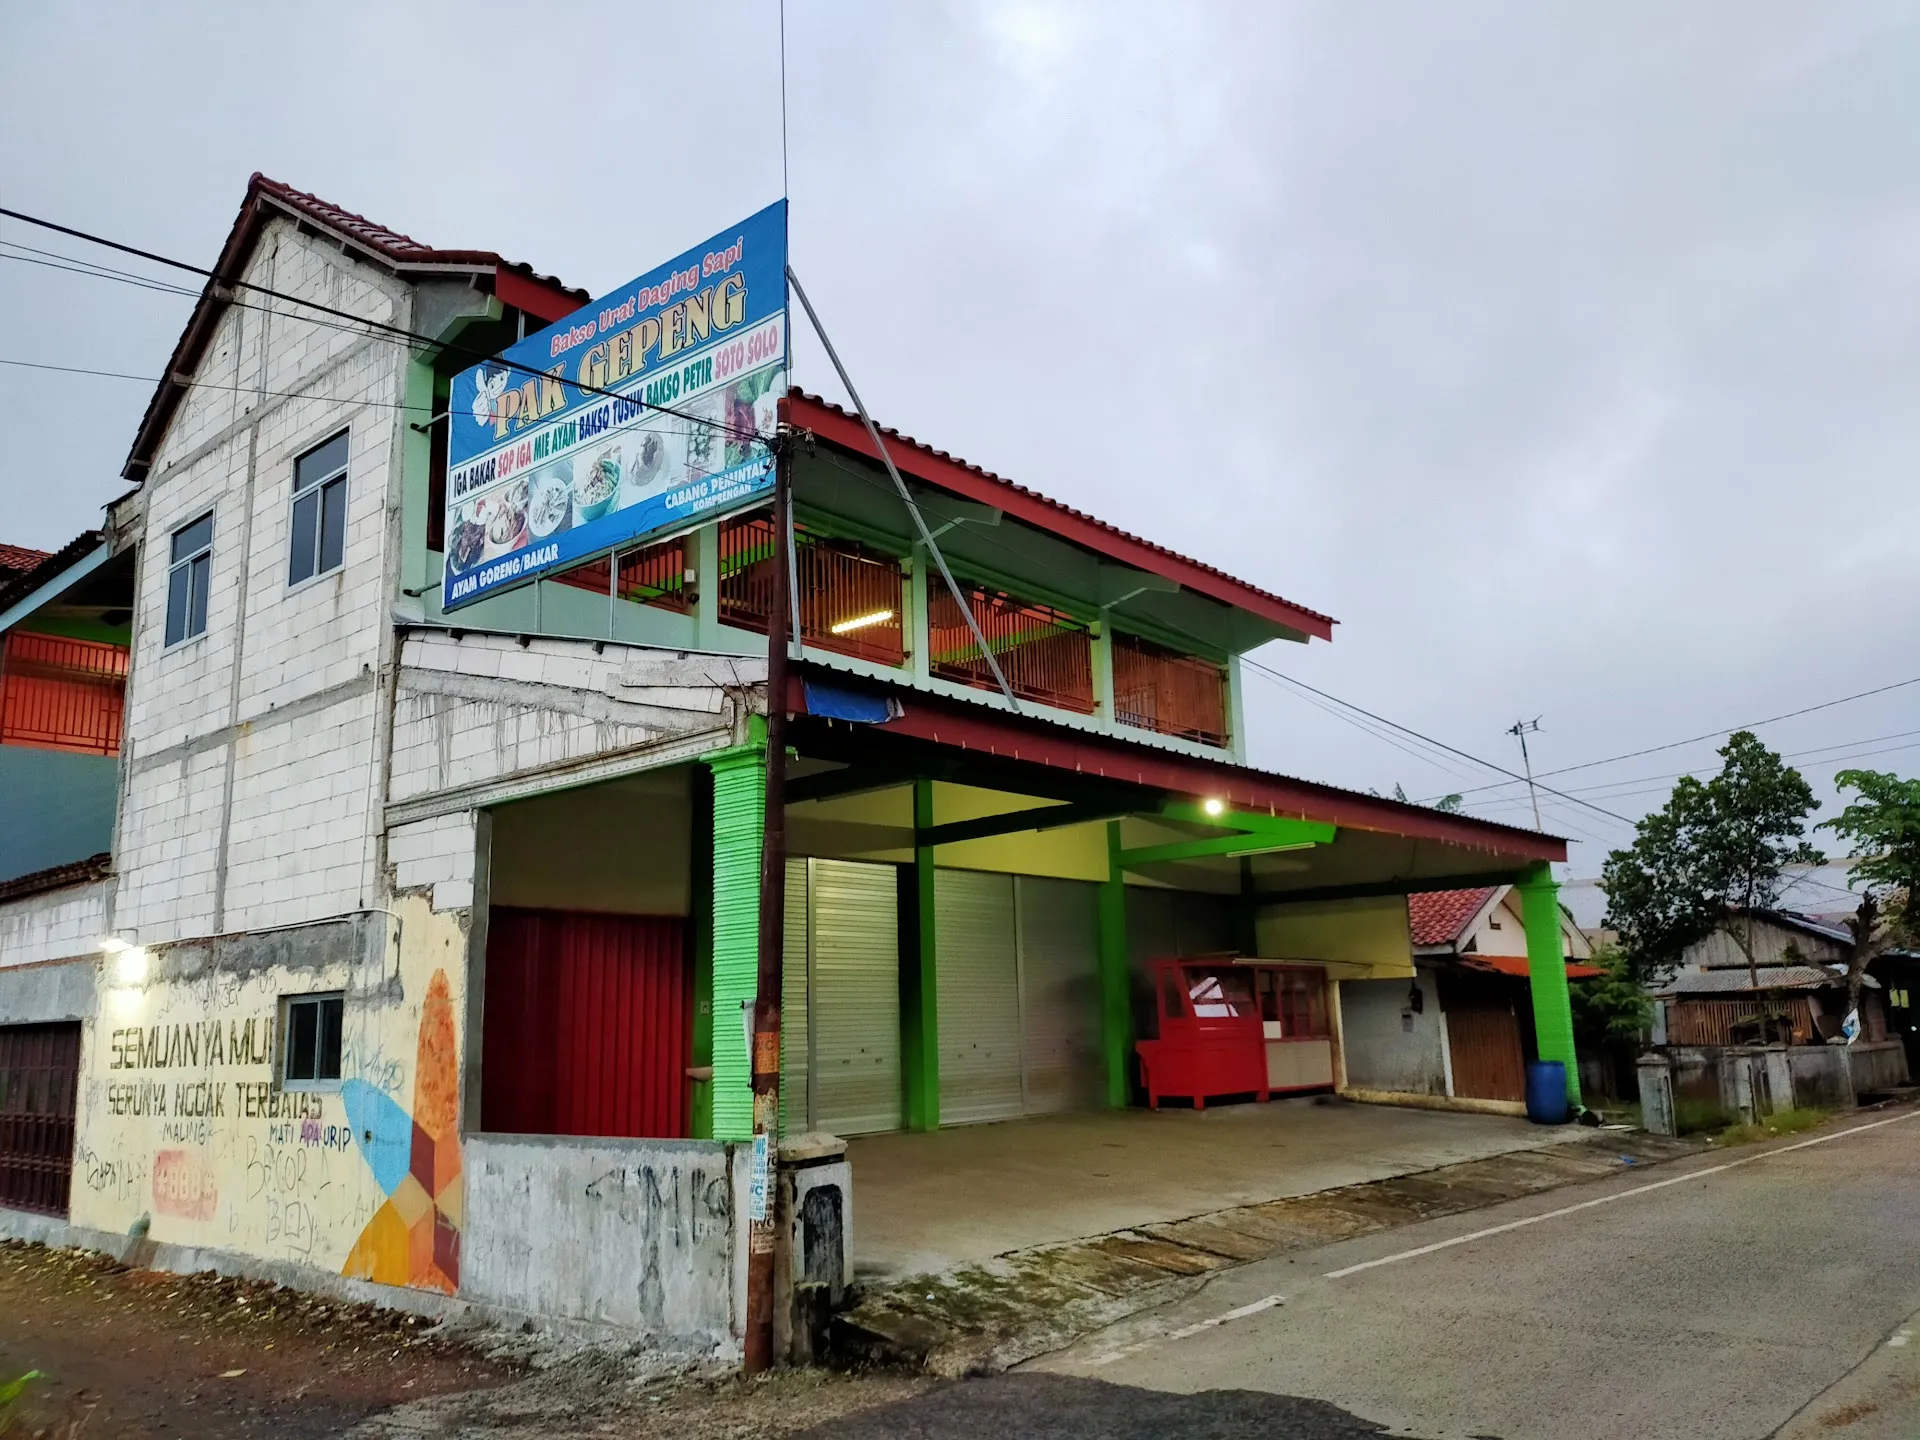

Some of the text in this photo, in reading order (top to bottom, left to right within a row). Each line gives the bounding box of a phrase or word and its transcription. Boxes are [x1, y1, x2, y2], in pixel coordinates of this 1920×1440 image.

[551, 236, 743, 356] Bakso Urat Daging Sapi
[493, 273, 746, 441] PAK GEPENG
[454, 325, 777, 498] IGA BAKAR SOP IGA MIE AYAM BAKSO TUSUK BAKSO PETIR SOTO SOLO
[665, 483, 708, 509] CABANG
[452, 543, 559, 600] AYAM GORENG/BAKAR
[110, 1017, 274, 1070] SEMUANYA MU
[108, 1082, 167, 1117] SERUNYA
[162, 1121, 205, 1145] MALING
[269, 1122, 294, 1145] MATI
[323, 1125, 351, 1152] URIP
